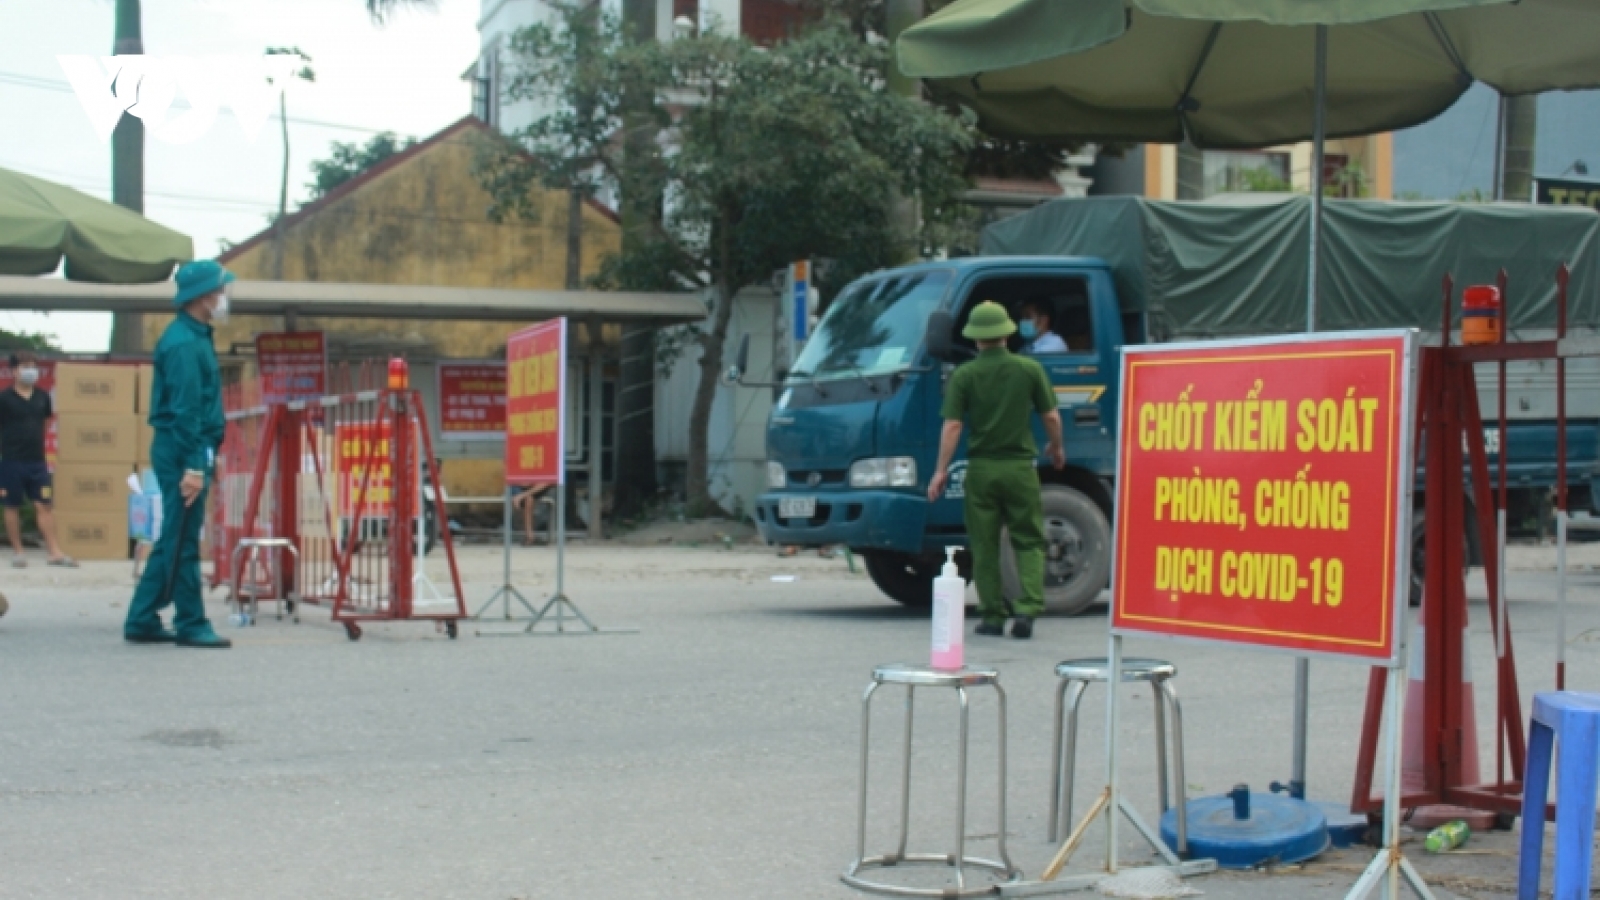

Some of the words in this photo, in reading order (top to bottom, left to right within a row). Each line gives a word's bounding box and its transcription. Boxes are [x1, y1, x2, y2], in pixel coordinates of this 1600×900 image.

[1138, 385, 1208, 452] CHỐT
[1213, 379, 1288, 452] KIỂM
[1296, 387, 1379, 452] SOÁT
[1154, 466, 1247, 531] PHÒNG,
[1254, 463, 1350, 531] CHỐNG
[1155, 546, 1214, 602] DỊCH
[1220, 550, 1344, 607] COVID-19
